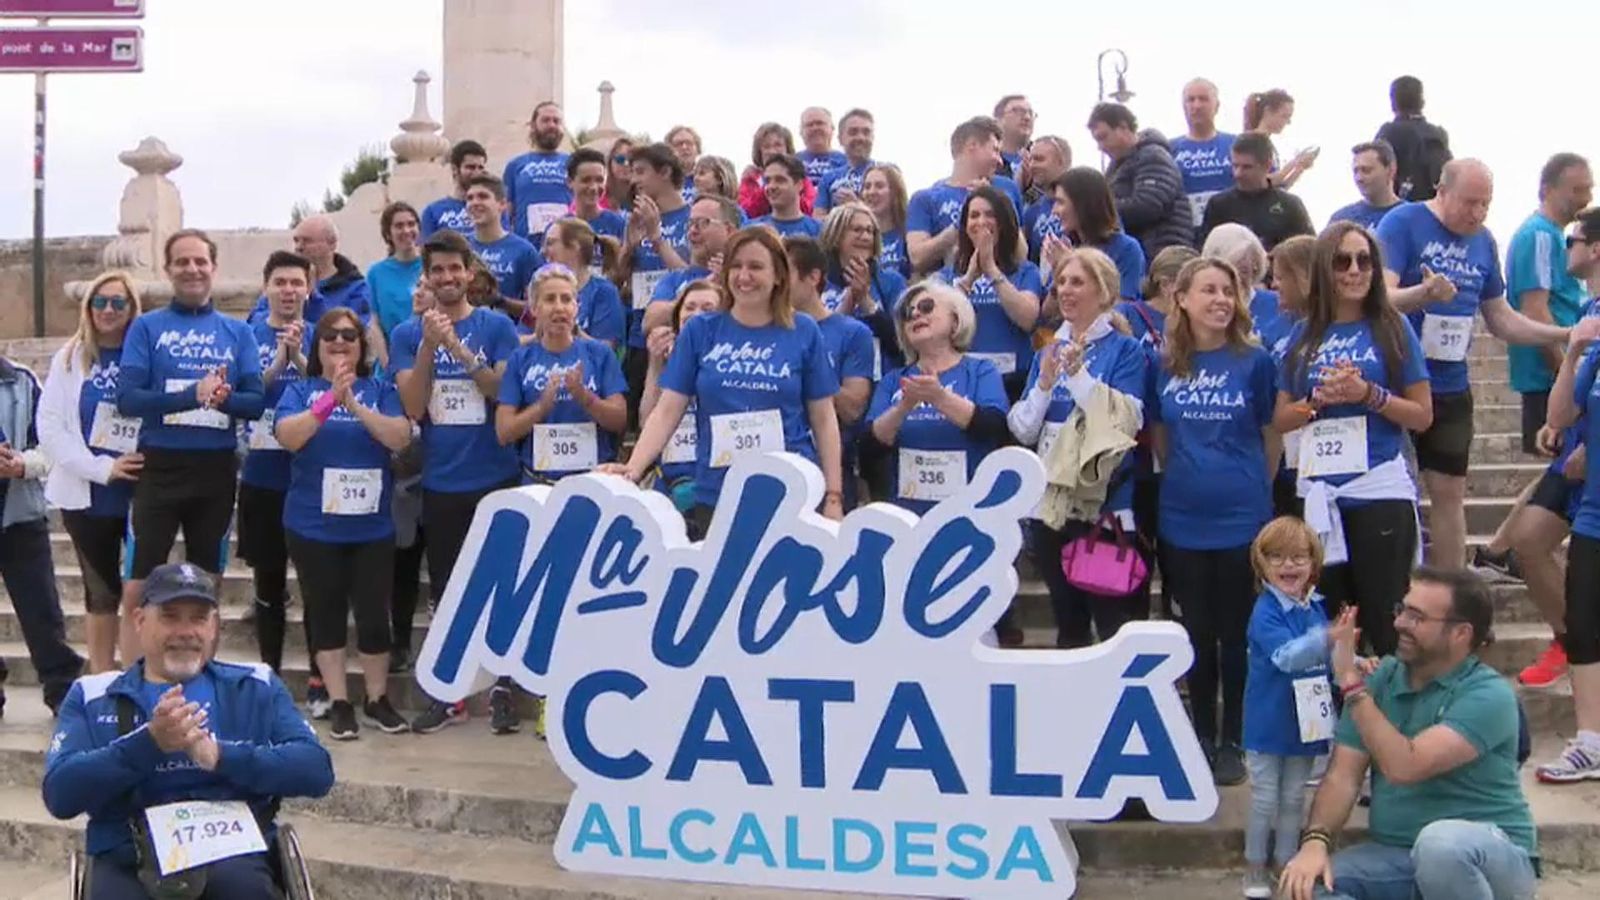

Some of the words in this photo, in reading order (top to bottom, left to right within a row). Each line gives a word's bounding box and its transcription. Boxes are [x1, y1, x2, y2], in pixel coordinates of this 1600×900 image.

[40, 42, 55, 53] de
[62, 42, 75, 53] la
[82, 42, 107, 53] Mar
[169, 345, 234, 362] CATALÁ
[716, 359, 791, 379] CATALÁ
[1175, 389, 1245, 408] CATALÁ
[111, 423, 136, 439] 313
[552, 442, 578, 455] 305
[735, 434, 761, 450] 301
[1316, 441, 1343, 457] 322
[918, 471, 945, 485] 336
[342, 487, 367, 500] 314
[651, 469, 1022, 668] José
[562, 653, 1196, 801] CATALÁ
[172, 820, 243, 846] 17.924
[570, 803, 1054, 884] ALCALDESA
